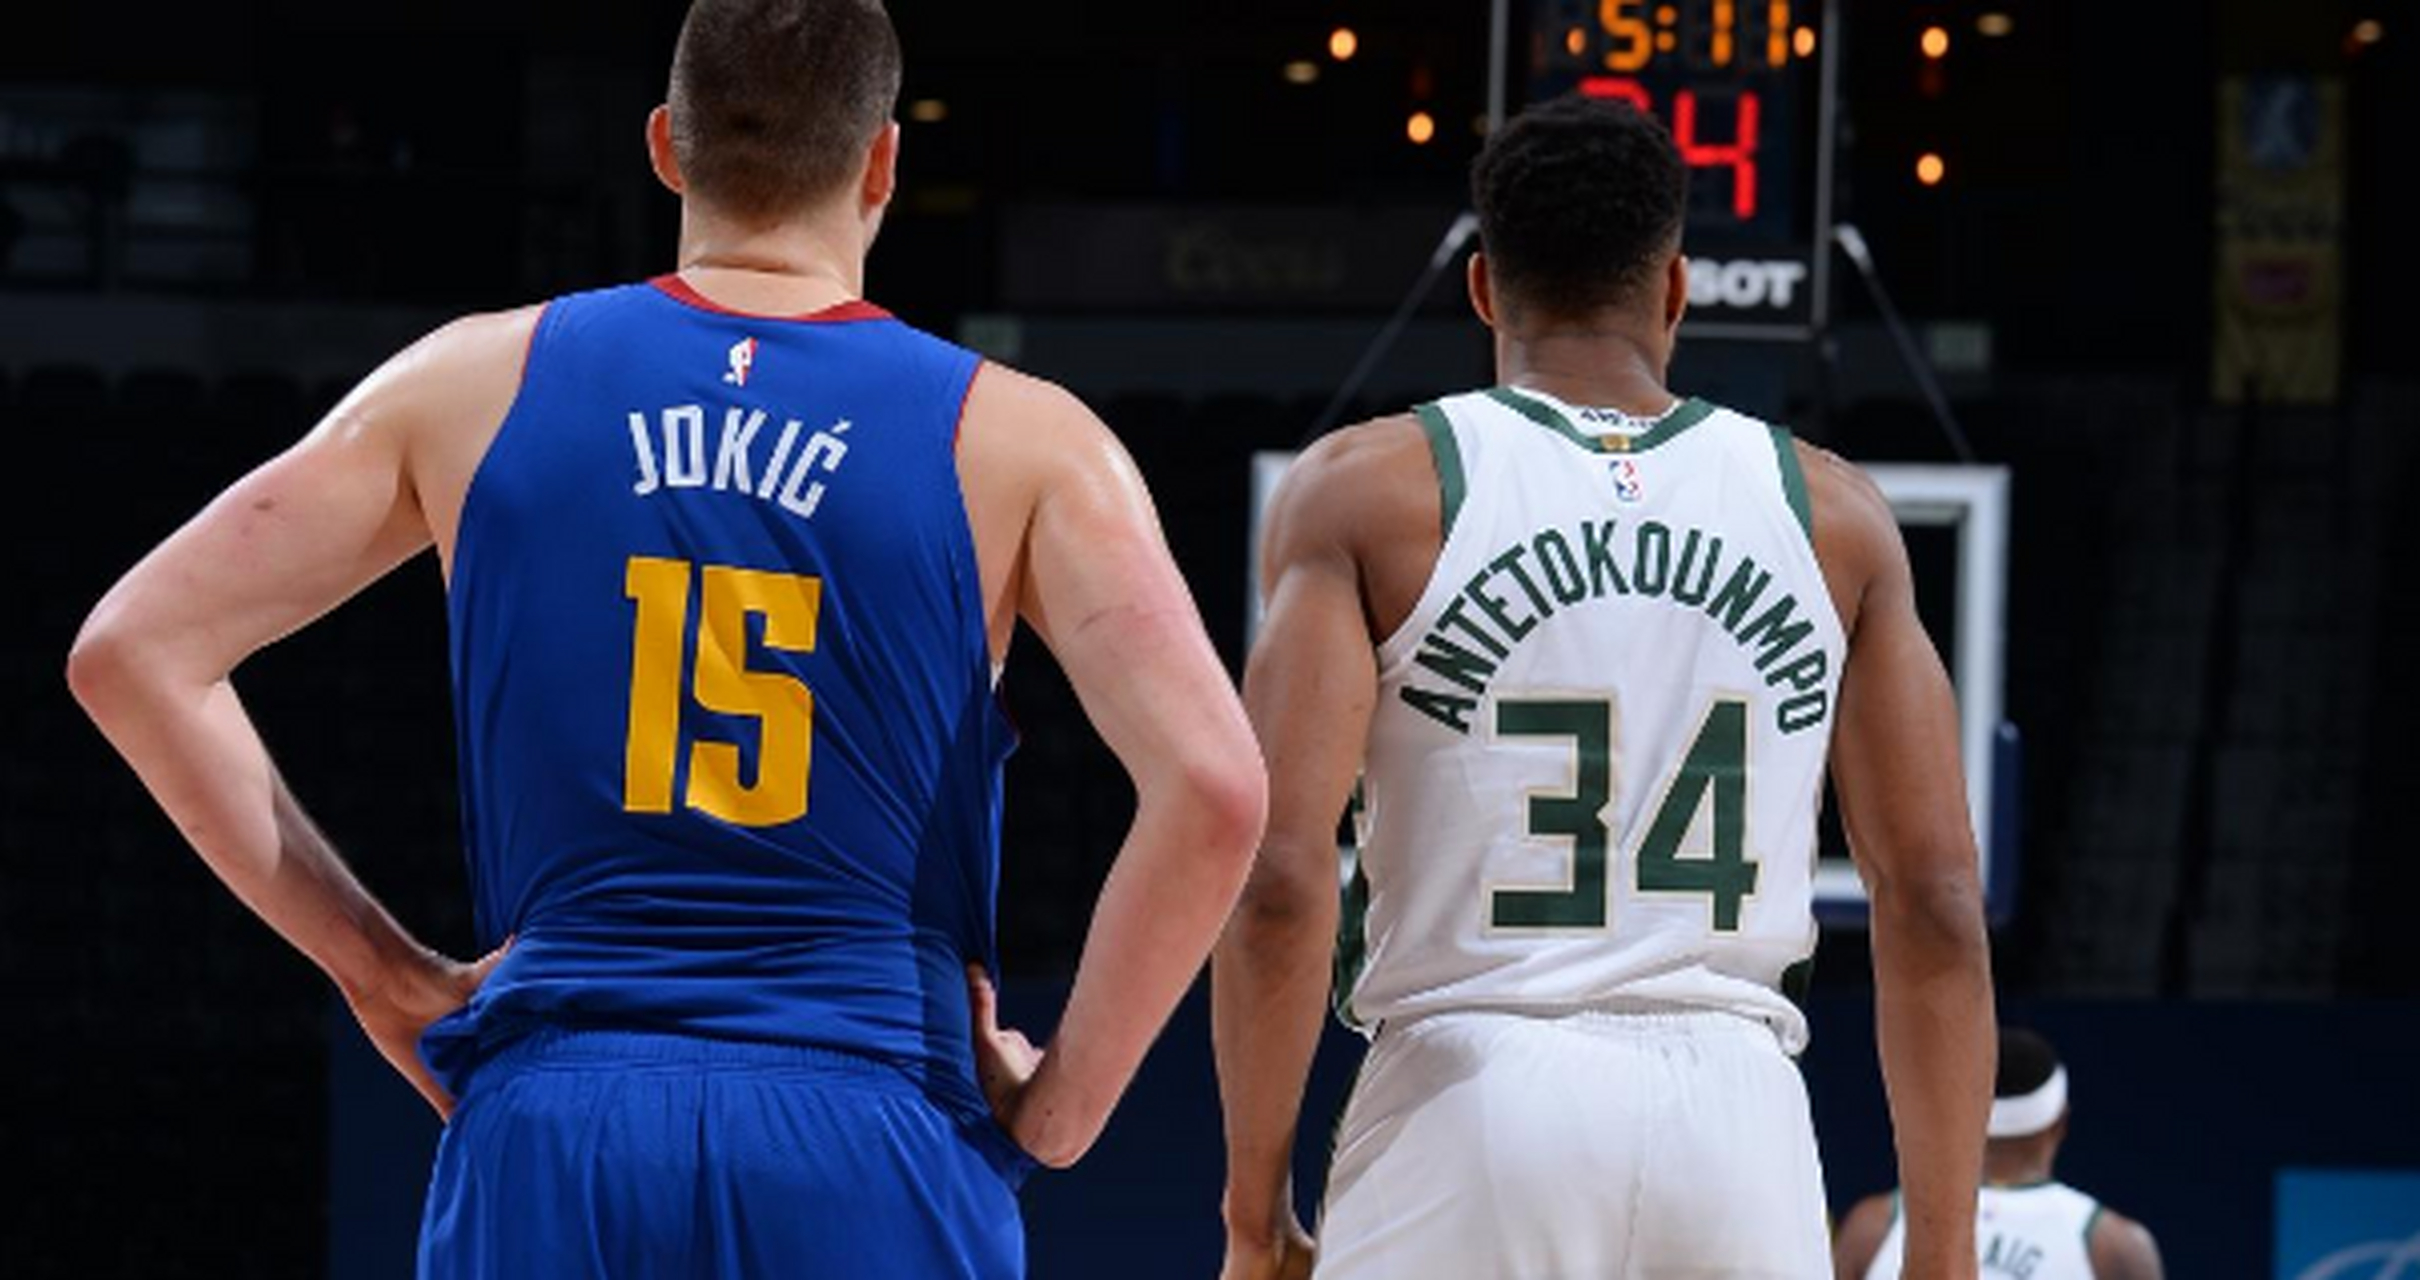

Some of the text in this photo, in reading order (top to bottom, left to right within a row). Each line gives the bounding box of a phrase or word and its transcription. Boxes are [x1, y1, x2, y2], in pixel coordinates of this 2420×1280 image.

[1599, 0, 1790, 71] 5:11
[1577, 74, 1762, 222] 4
[628, 404, 851, 518] JOKIĆ
[623, 556, 821, 827] 15
[1400, 520, 1828, 735] ANTETOKOUNMPO
[1486, 692, 1762, 936] 34
